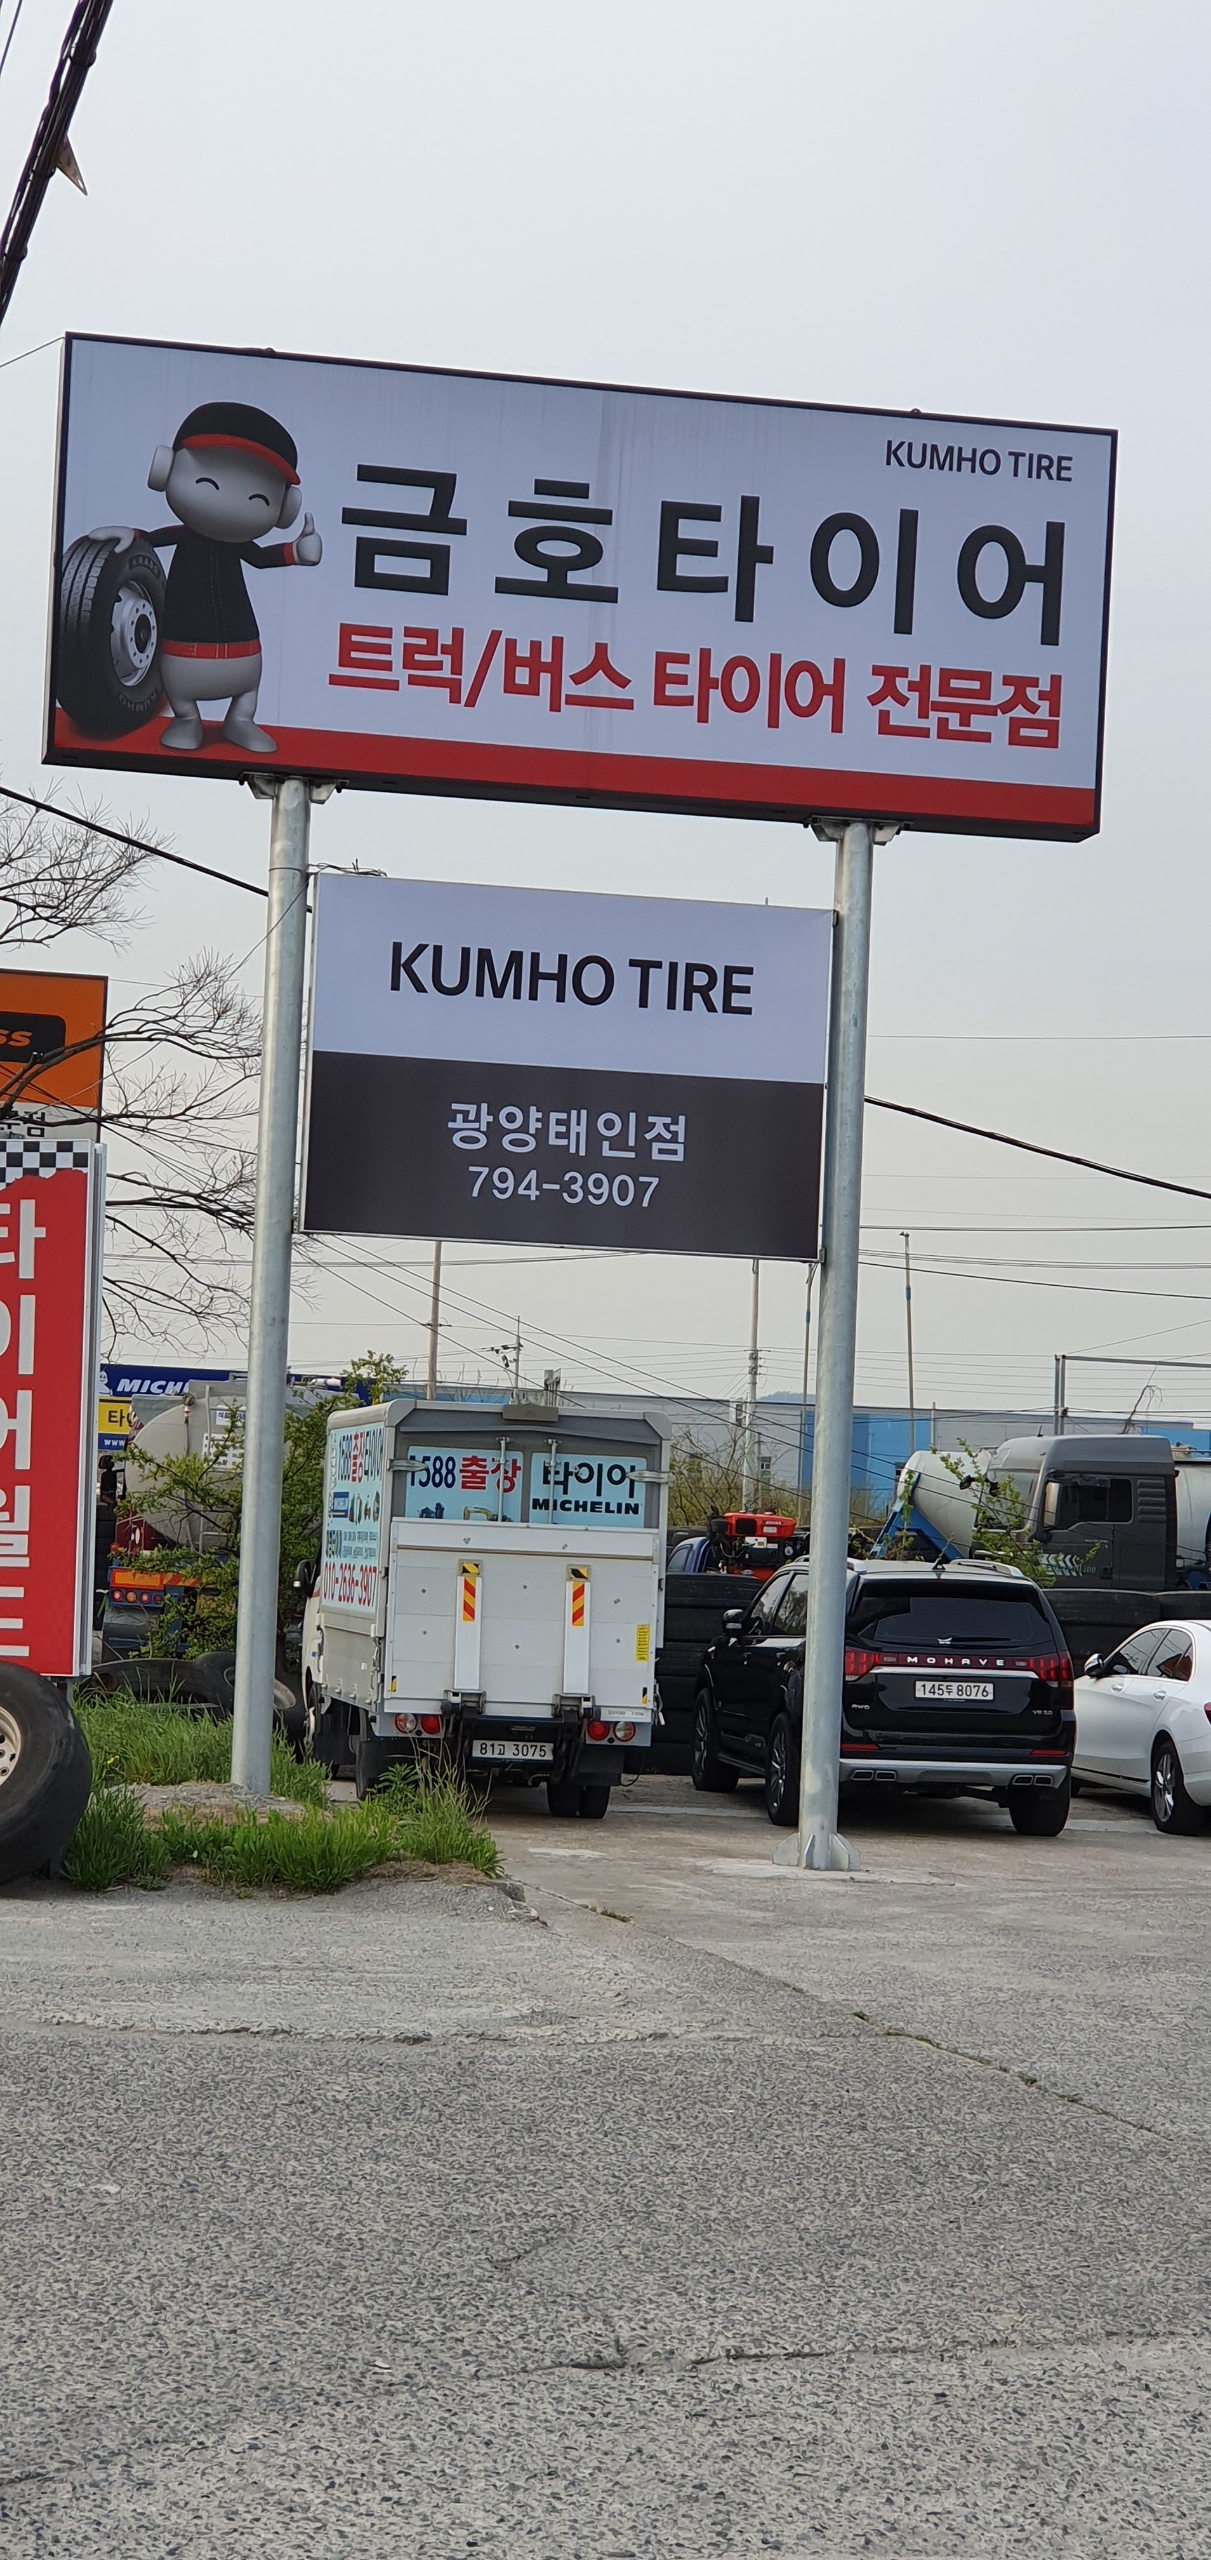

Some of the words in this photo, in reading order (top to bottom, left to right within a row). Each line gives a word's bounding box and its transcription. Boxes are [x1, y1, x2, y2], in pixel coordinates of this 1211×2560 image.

[886, 440, 1001, 476] KUMHO
[1007, 451, 1073, 482] TIRE
[342, 464, 1066, 647] 금호타이어
[328, 622, 635, 713] 트럭/버스
[653, 647, 846, 734] 타이어
[866, 663, 1063, 749] 전문점
[389, 941, 615, 1006] KUMHO
[628, 958, 754, 1016] TIRE
[447, 1102, 687, 1162] 광양태인점
[468, 1166, 660, 1207] 794-3907
[117, 1378, 189, 1395] MICH
[542, 1461, 636, 1499] 타이어
[532, 1498, 640, 1516] MICHELIN
[907, 1655, 1006, 1667] MOHAVE
[512, 1743, 547, 1758] 3075
